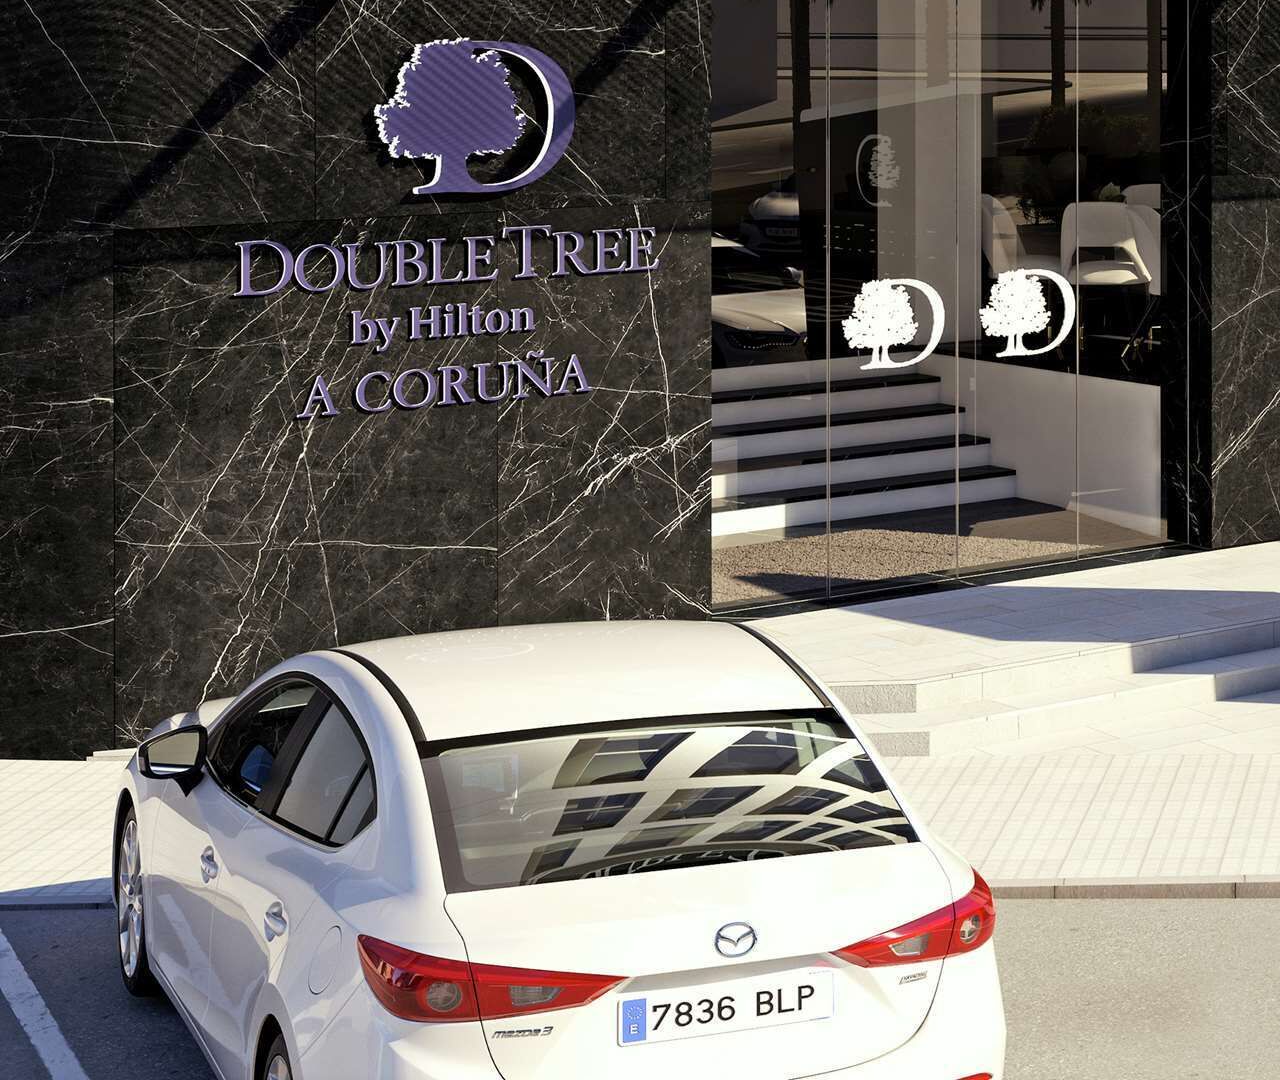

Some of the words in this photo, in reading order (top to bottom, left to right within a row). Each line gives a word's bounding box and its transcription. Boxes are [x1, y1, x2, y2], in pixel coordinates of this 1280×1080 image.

[351, 311, 400, 352] by
[409, 302, 534, 340] Hilton
[297, 375, 338, 418] A
[355, 350, 593, 412] CORUÑA
[630, 1024, 639, 1034] E
[652, 996, 736, 1031] 7836
[756, 984, 815, 1017] BLP
